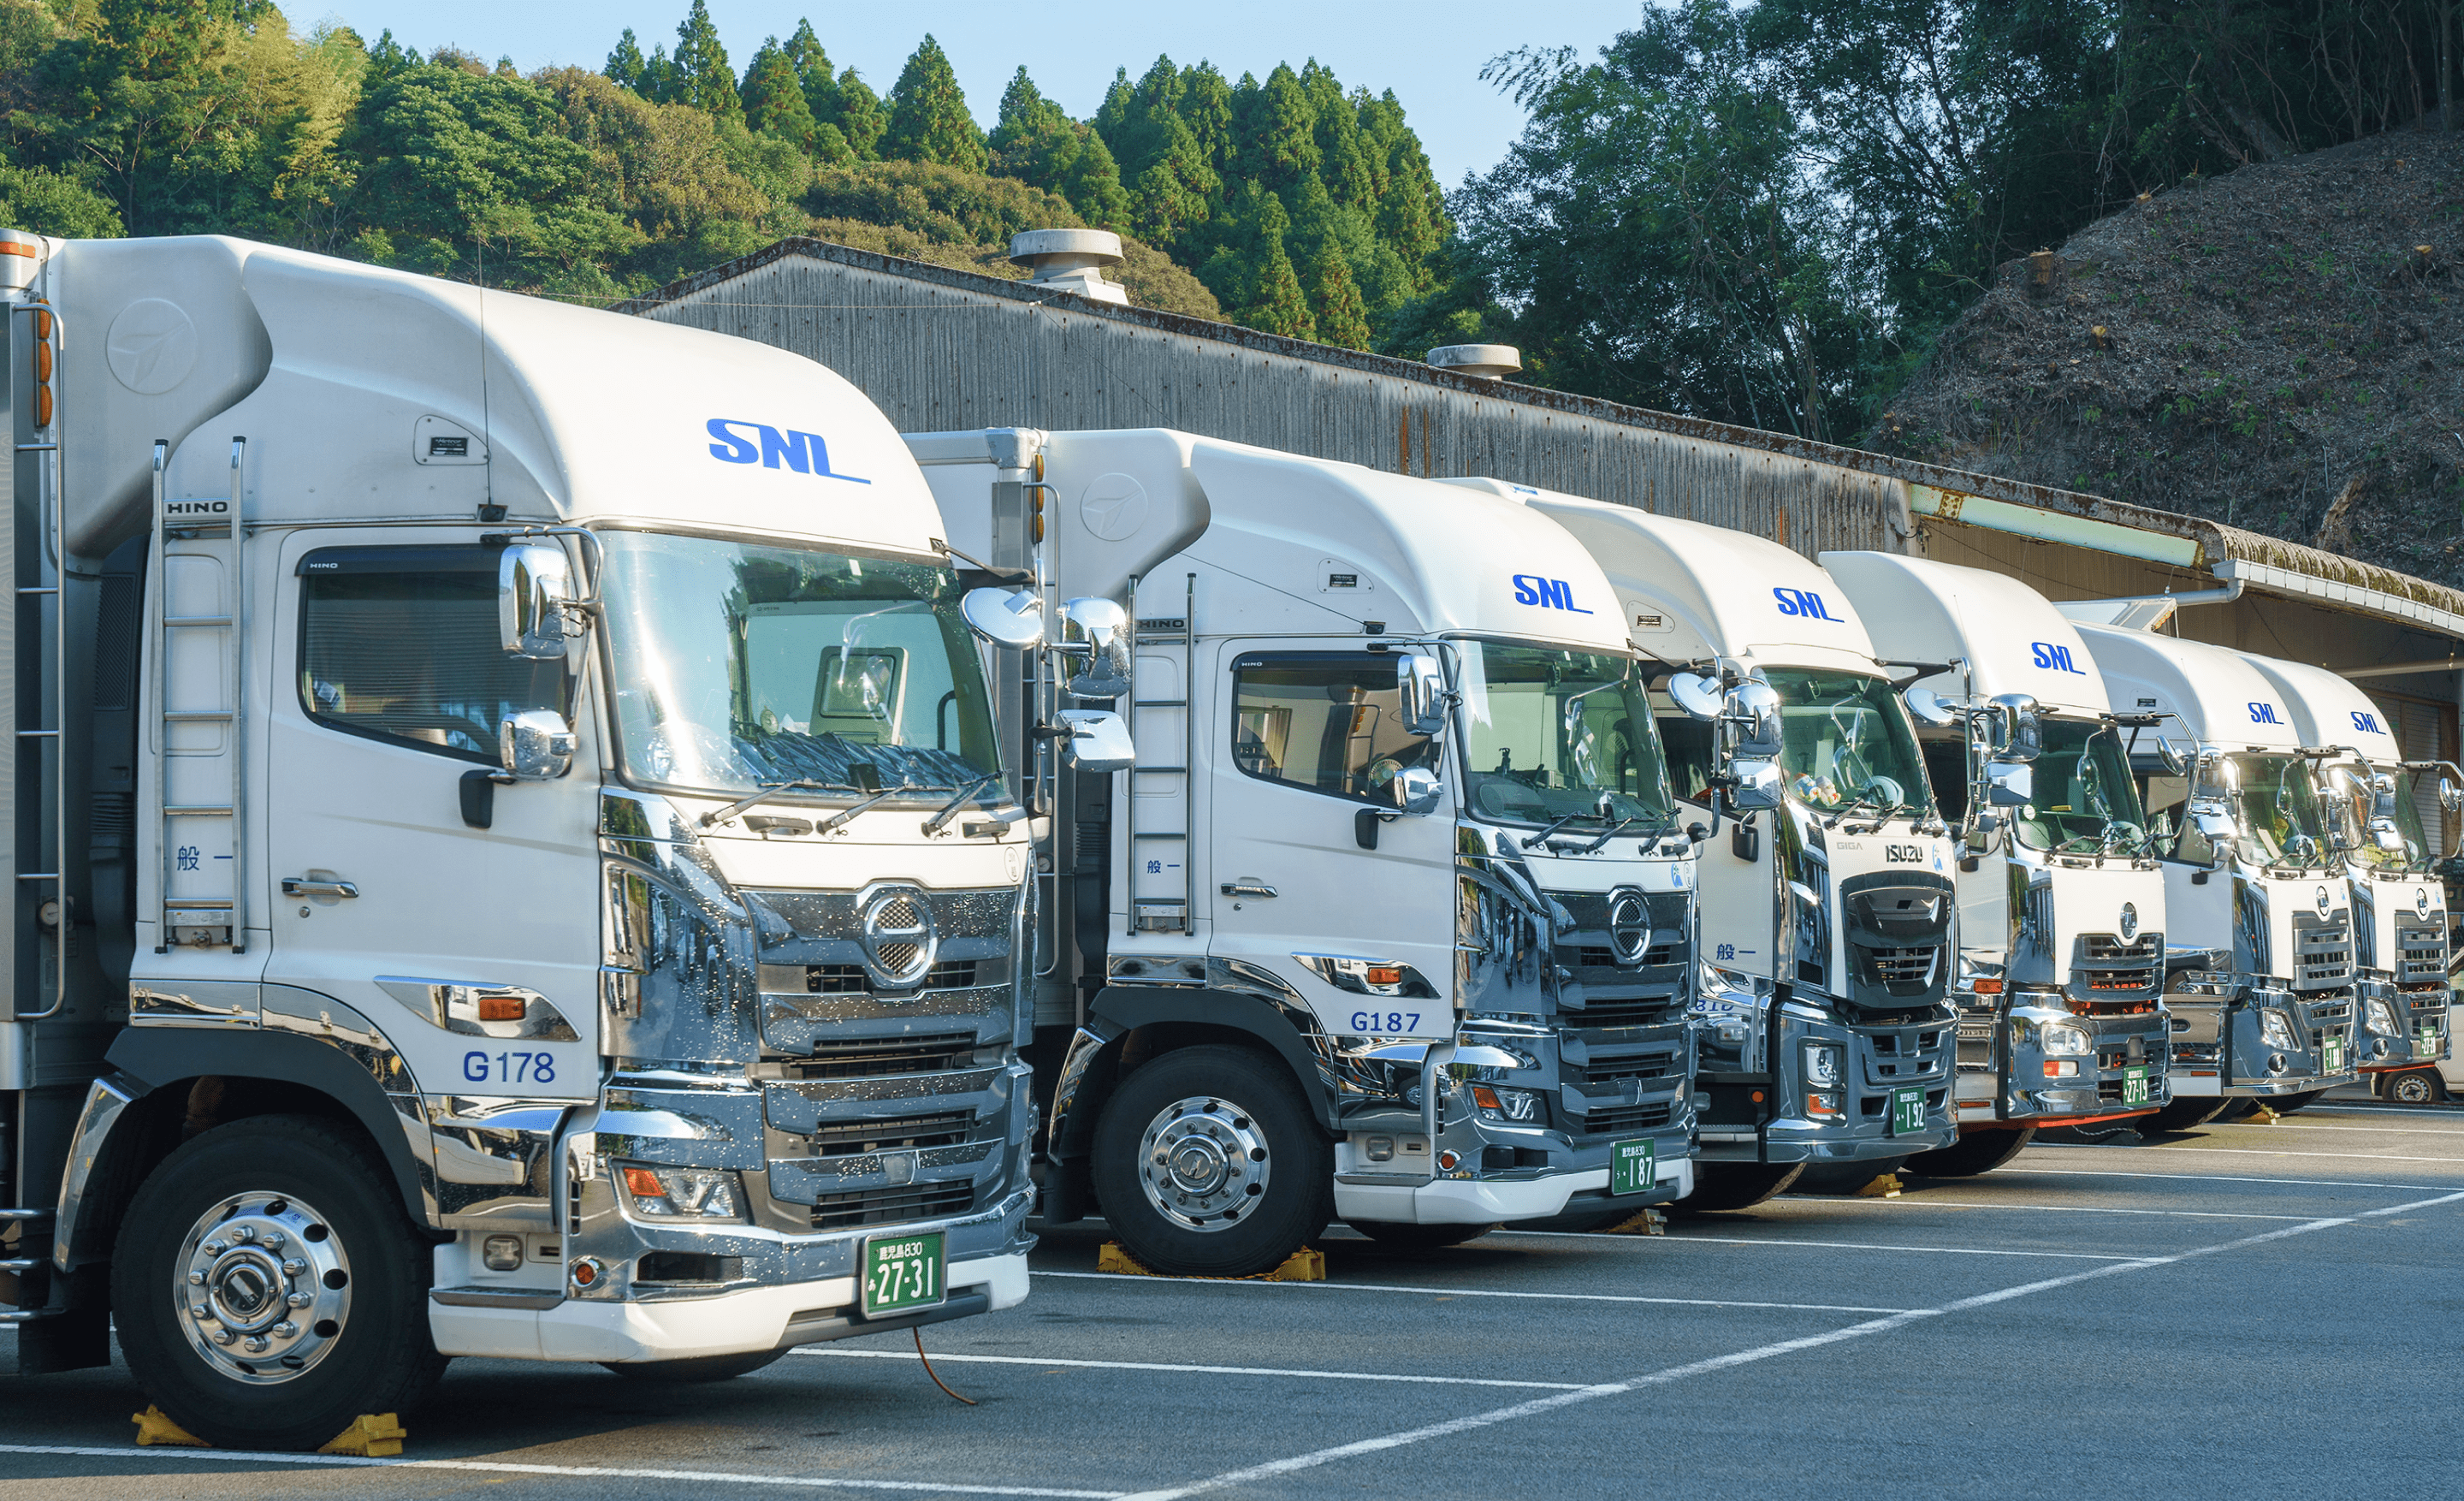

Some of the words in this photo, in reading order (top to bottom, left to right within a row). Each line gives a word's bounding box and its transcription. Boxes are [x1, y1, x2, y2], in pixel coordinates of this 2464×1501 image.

[707, 418, 872, 484] SNL
[168, 501, 228, 513] HINO
[1513, 574, 1594, 614] SNL
[1773, 587, 1845, 623] SNL
[2031, 642, 2086, 675] SNL
[2248, 702, 2284, 724] SNL
[2350, 711, 2386, 735] SNL
[1885, 845, 1923, 863] ISUZU
[1351, 1012, 1421, 1033] G187
[463, 1051, 556, 1083] G178
[2127, 1079, 2147, 1102] 27-19
[877, 1257, 933, 1304] 27-31
